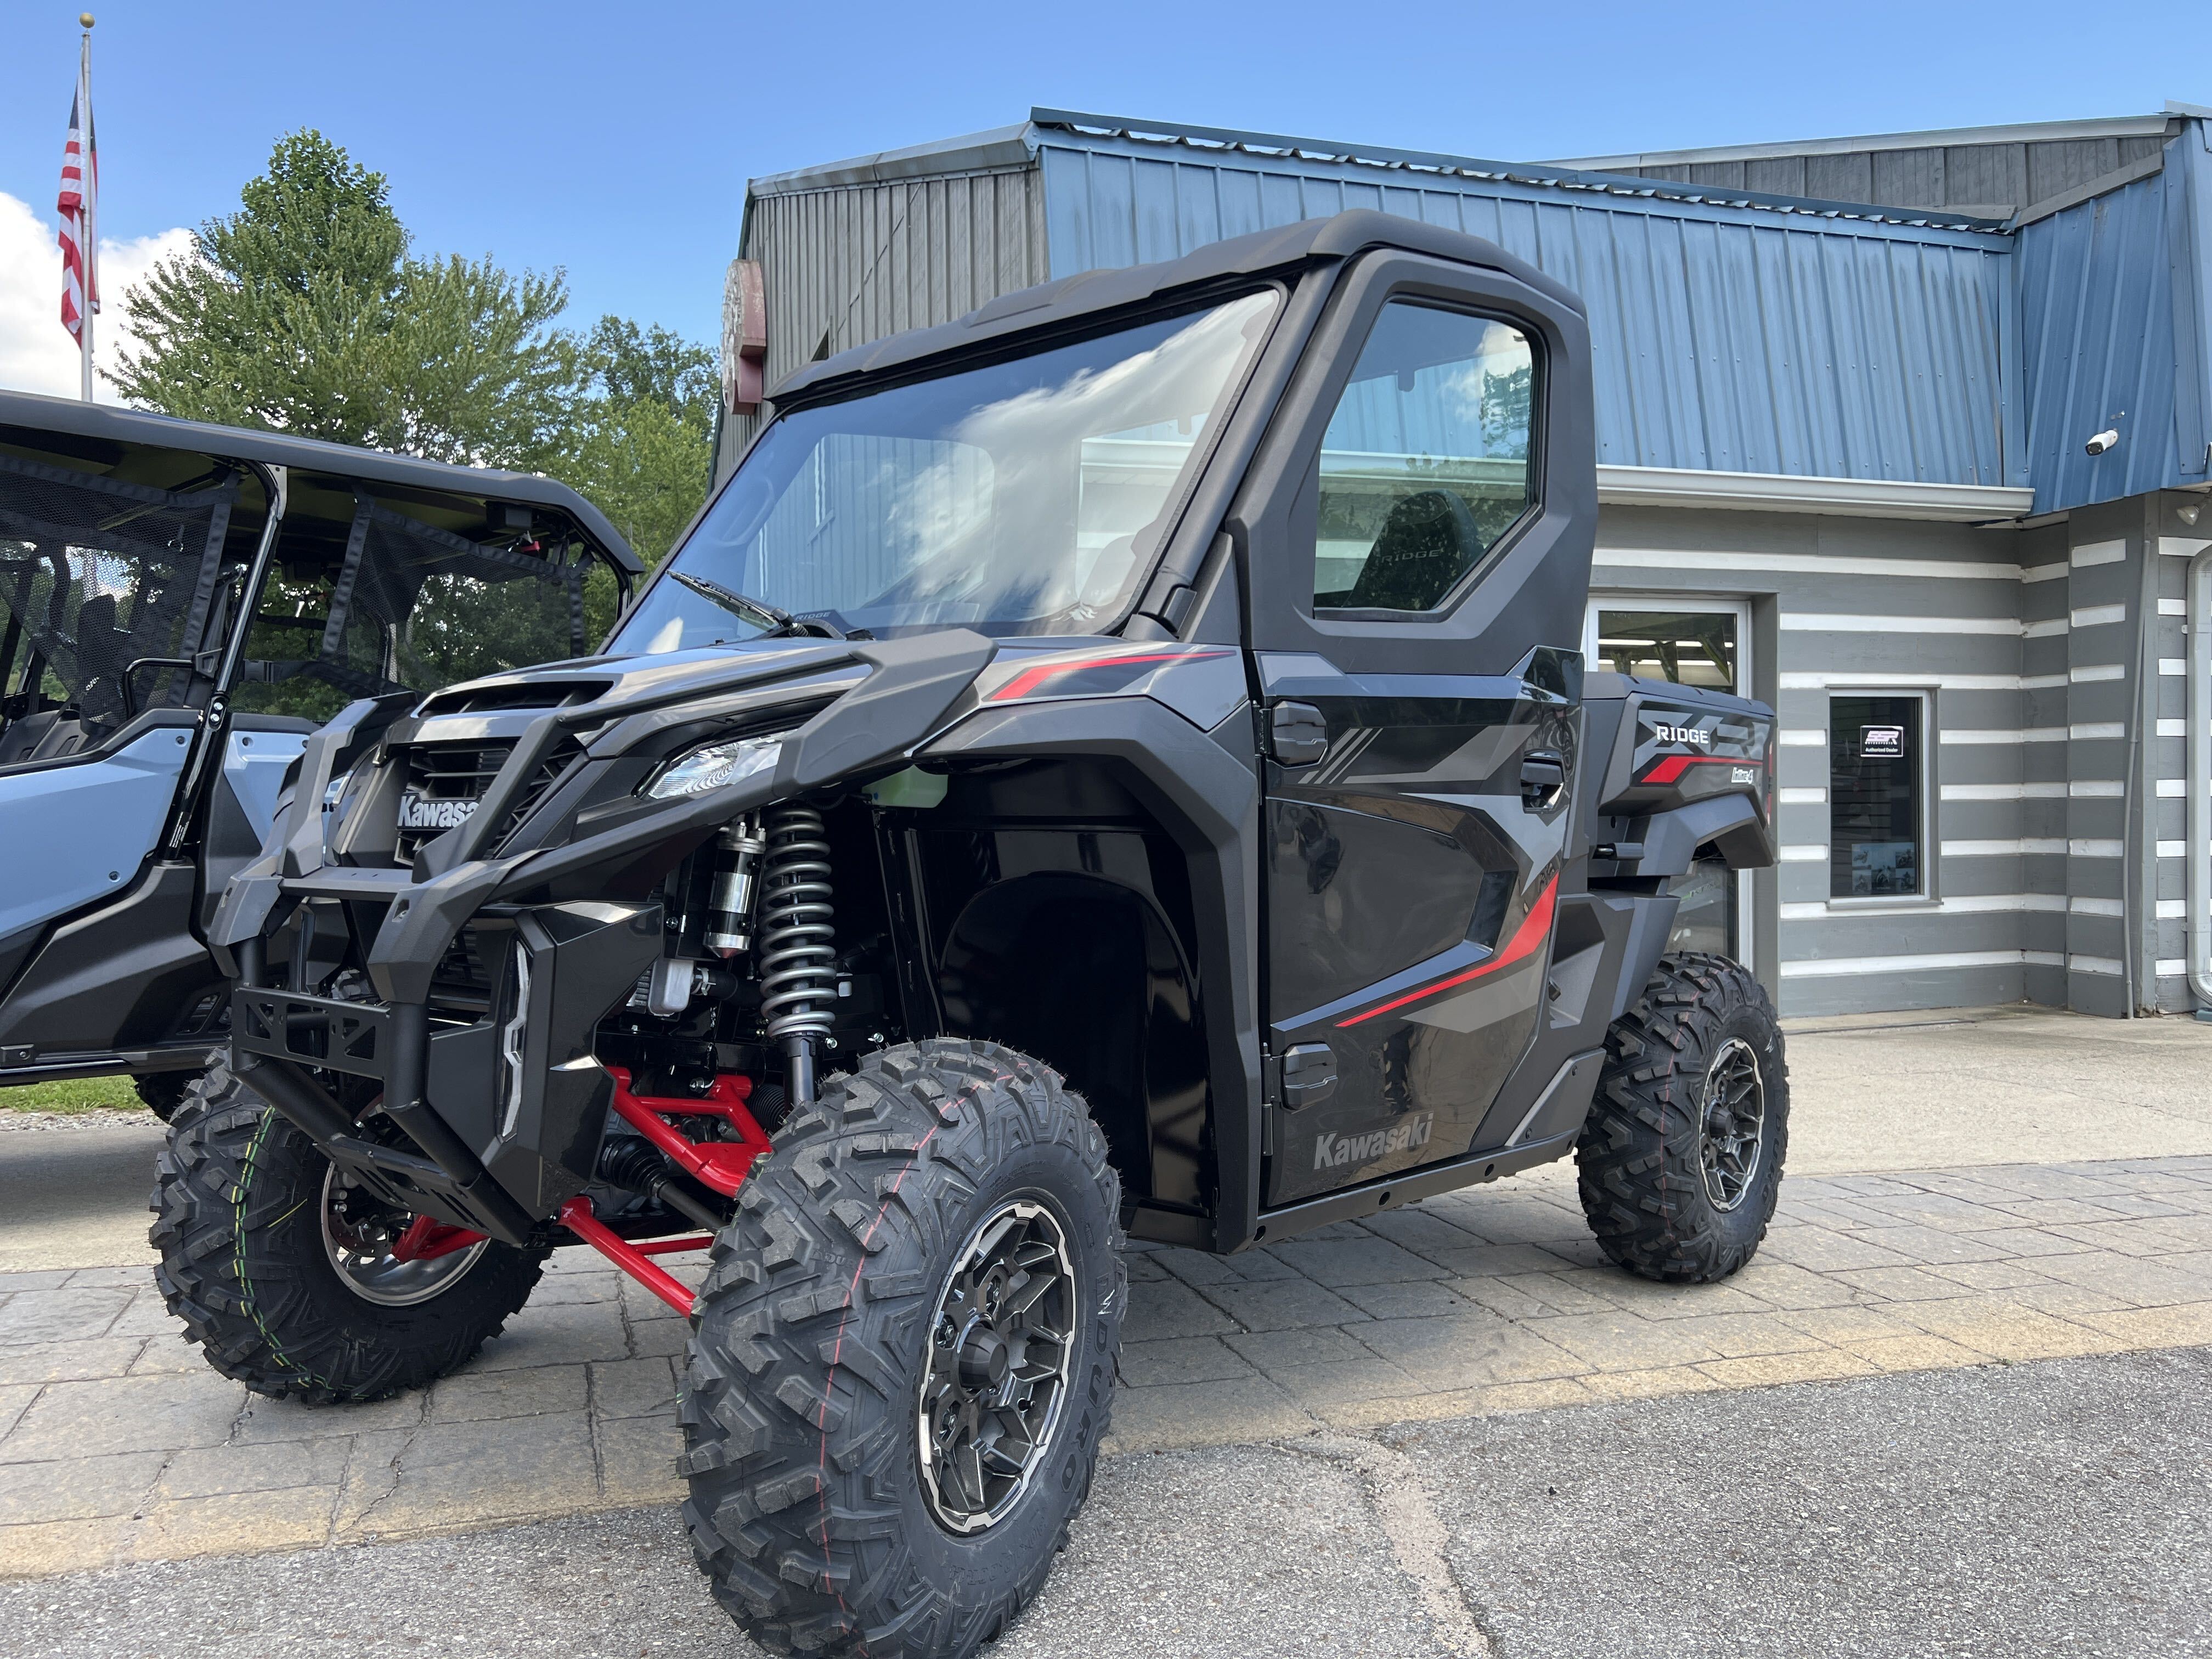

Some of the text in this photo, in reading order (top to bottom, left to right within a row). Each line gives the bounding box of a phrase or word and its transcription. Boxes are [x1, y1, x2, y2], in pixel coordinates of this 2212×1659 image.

[1381, 549, 1441, 563] RIDGE
[795, 611, 831, 620] RIDGE
[1656, 725, 1709, 744] RIDGE
[1865, 730, 1899, 745] SSR
[397, 795, 479, 828] Kawasa
[1313, 1113, 1434, 1170] Kawasaki
[1062, 1319, 1108, 1492] DURO
